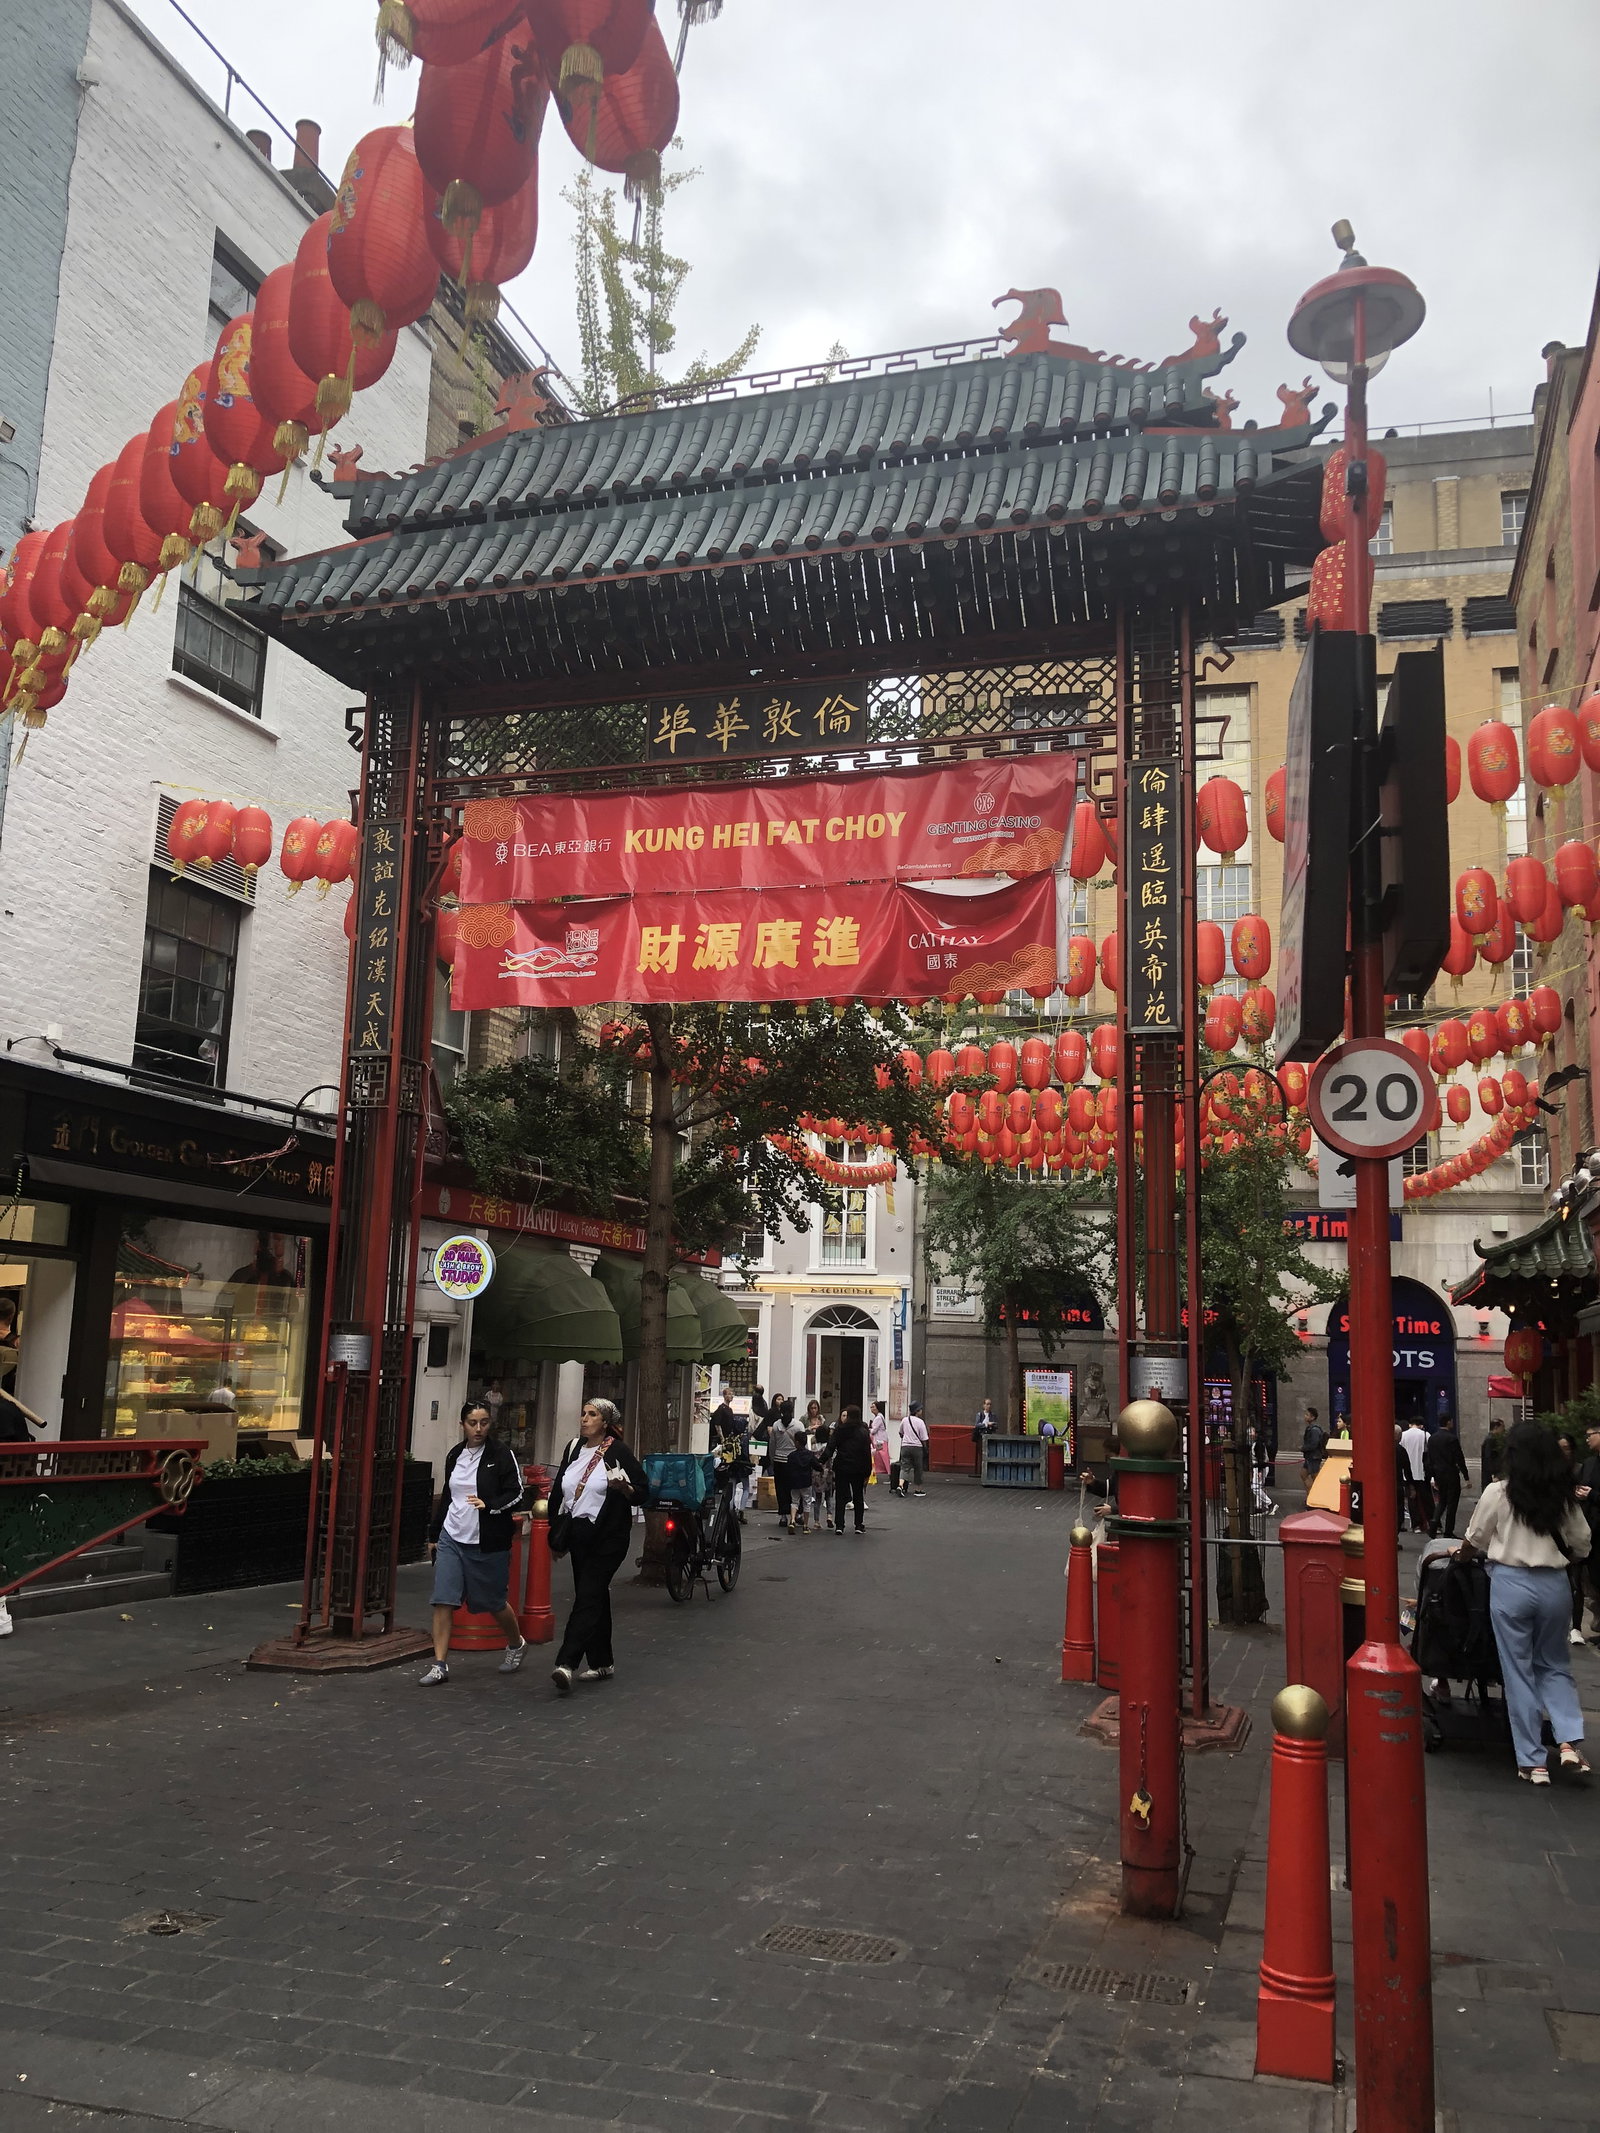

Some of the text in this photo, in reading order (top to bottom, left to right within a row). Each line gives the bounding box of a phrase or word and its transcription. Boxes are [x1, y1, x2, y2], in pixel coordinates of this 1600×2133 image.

[625, 812, 907, 853] KUNG HEI FAT CHOY
[927, 815, 1042, 836] GENTING CASINO
[952, 833, 987, 844] CHINATOWN
[513, 838, 612, 857] BEA 東亞銀行
[566, 929, 599, 941] HONG
[908, 932, 985, 950] CATHAY
[566, 939, 599, 951] KONG
[636, 916, 861, 974] 財源廣進
[927, 953, 958, 970] 國泰
[1058, 1049, 1080, 1057] LNER
[1100, 1044, 1117, 1053] LNE
[1023, 1056, 1044, 1065] LNER
[1329, 1073, 1418, 1122] 20
[516, 1203, 559, 1234] TIANFU
[457, 1251, 482, 1264] NAILS
[463, 1263, 484, 1271] BROWS
[441, 1269, 480, 1284] STUDIO
[1351, 1491, 1359, 1509] 2
